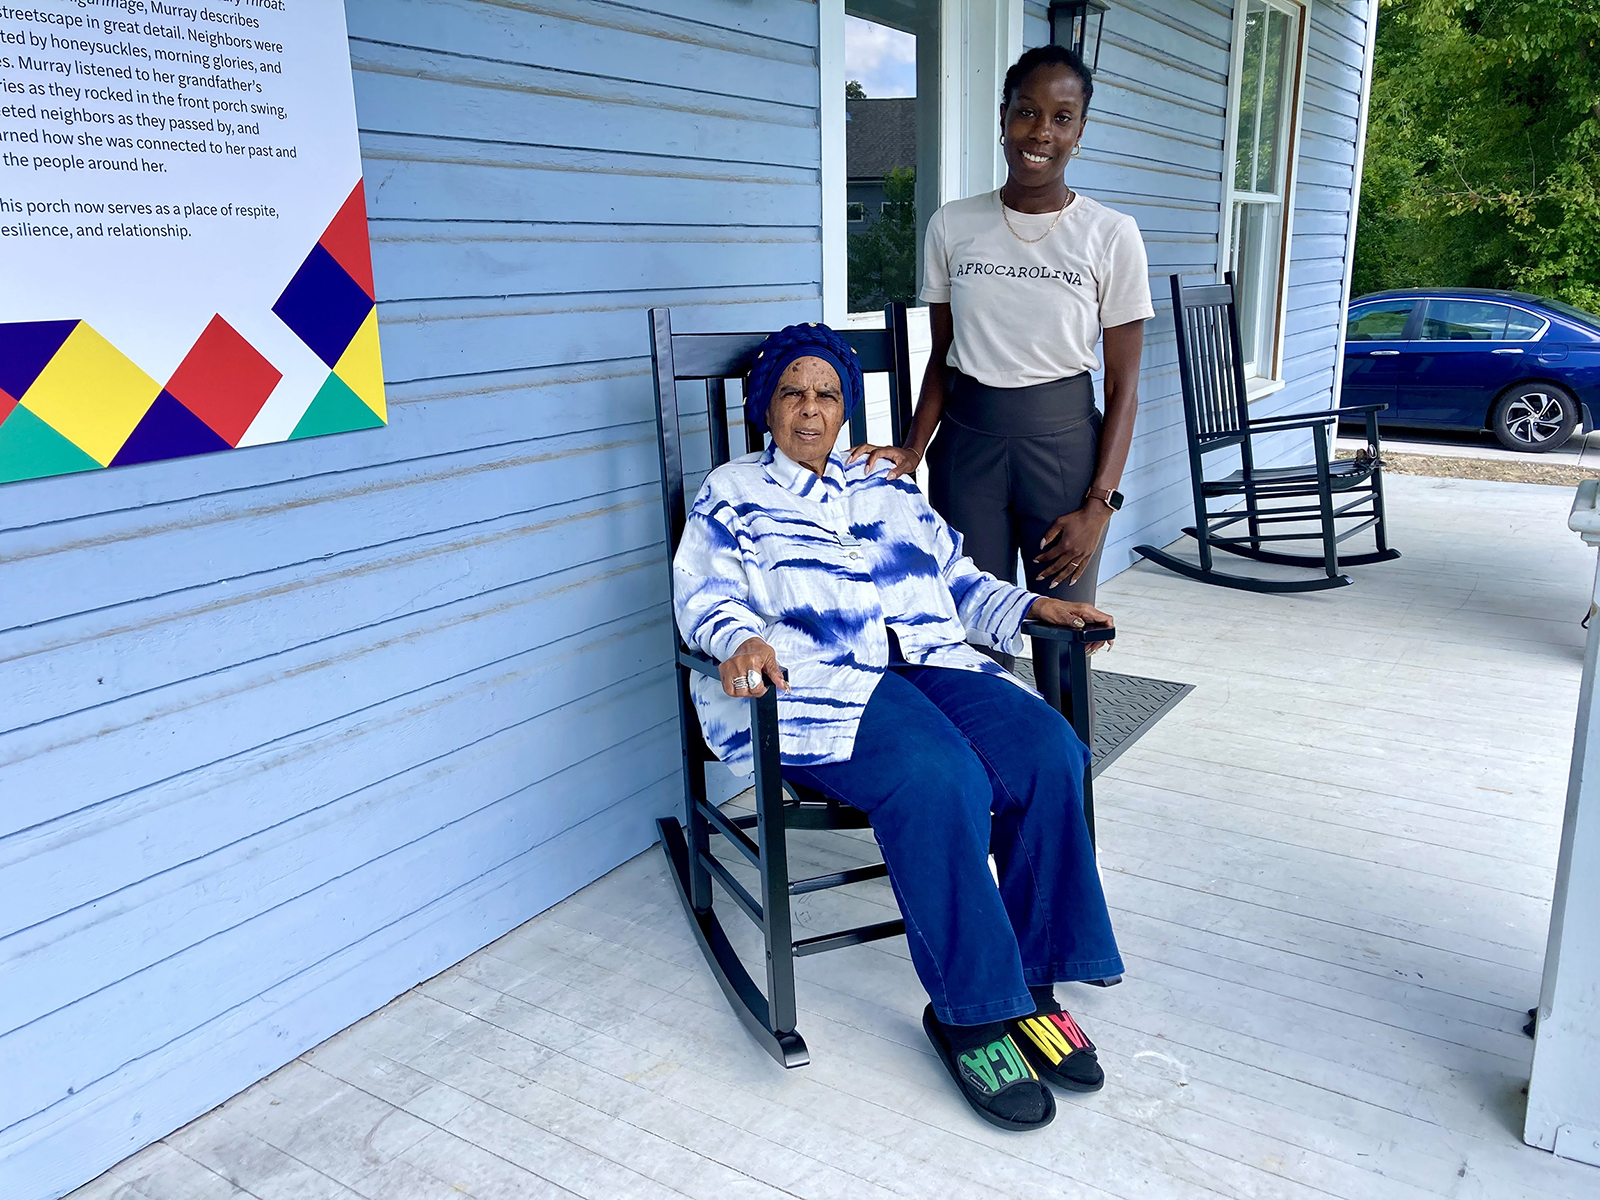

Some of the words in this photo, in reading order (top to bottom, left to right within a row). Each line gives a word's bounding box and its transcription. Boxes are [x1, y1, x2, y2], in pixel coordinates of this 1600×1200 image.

[150, 0, 198, 23] Murray
[199, 6, 260, 29] describes
[85, 13, 101, 30] in
[103, 19, 142, 35] great
[142, 21, 185, 41] detail.
[187, 27, 253, 50] Neighbors
[253, 39, 284, 54] were
[28, 30, 48, 51] by
[49, 32, 152, 62] honeysuckles,
[153, 48, 211, 70] morning
[212, 53, 258, 75] glories,
[259, 60, 282, 75] and
[0, 56, 15, 69] s.
[17, 55, 72, 77] Murray
[74, 59, 133, 80] listened
[134, 67, 150, 82] to
[152, 67, 176, 84] her
[177, 74, 263, 94] grandfather’s
[0, 77, 26, 94] ies
[28, 83, 46, 96] as
[47, 81, 82, 102] they
[84, 85, 134, 103] rocked
[135, 89, 150, 105] in
[151, 90, 175, 107] the
[176, 92, 211, 110] front
[211, 98, 249, 114] porch
[250, 102, 288, 121] swing,
[40, 106, 116, 126] neighbors
[117, 114, 134, 126] as
[135, 112, 166, 132] they
[168, 117, 215, 133] passed
[216, 118, 235, 137] by,
[236, 121, 260, 136] and
[0, 128, 39, 144] rned
[41, 128, 75, 145] how
[76, 131, 104, 147] she
[105, 136, 134, 149] was
[136, 138, 207, 153] connected
[208, 140, 223, 155] to
[224, 140, 246, 156] her
[247, 145, 274, 160] past
[275, 145, 298, 159] and
[1, 151, 29, 167] the
[32, 153, 85, 173] people
[87, 157, 139, 172] around
[140, 157, 168, 173] her.
[0, 197, 24, 213] his
[26, 198, 71, 217] porch
[73, 202, 105, 214] now
[107, 203, 153, 215] serves
[154, 204, 171, 216] as
[172, 204, 181, 216] a
[183, 201, 218, 219] place
[220, 202, 233, 217] of
[234, 204, 280, 220] respite,
[75, 222, 104, 237] and
[106, 222, 192, 241] relationship.
[956, 262, 1083, 286] AFROCAROLINA
